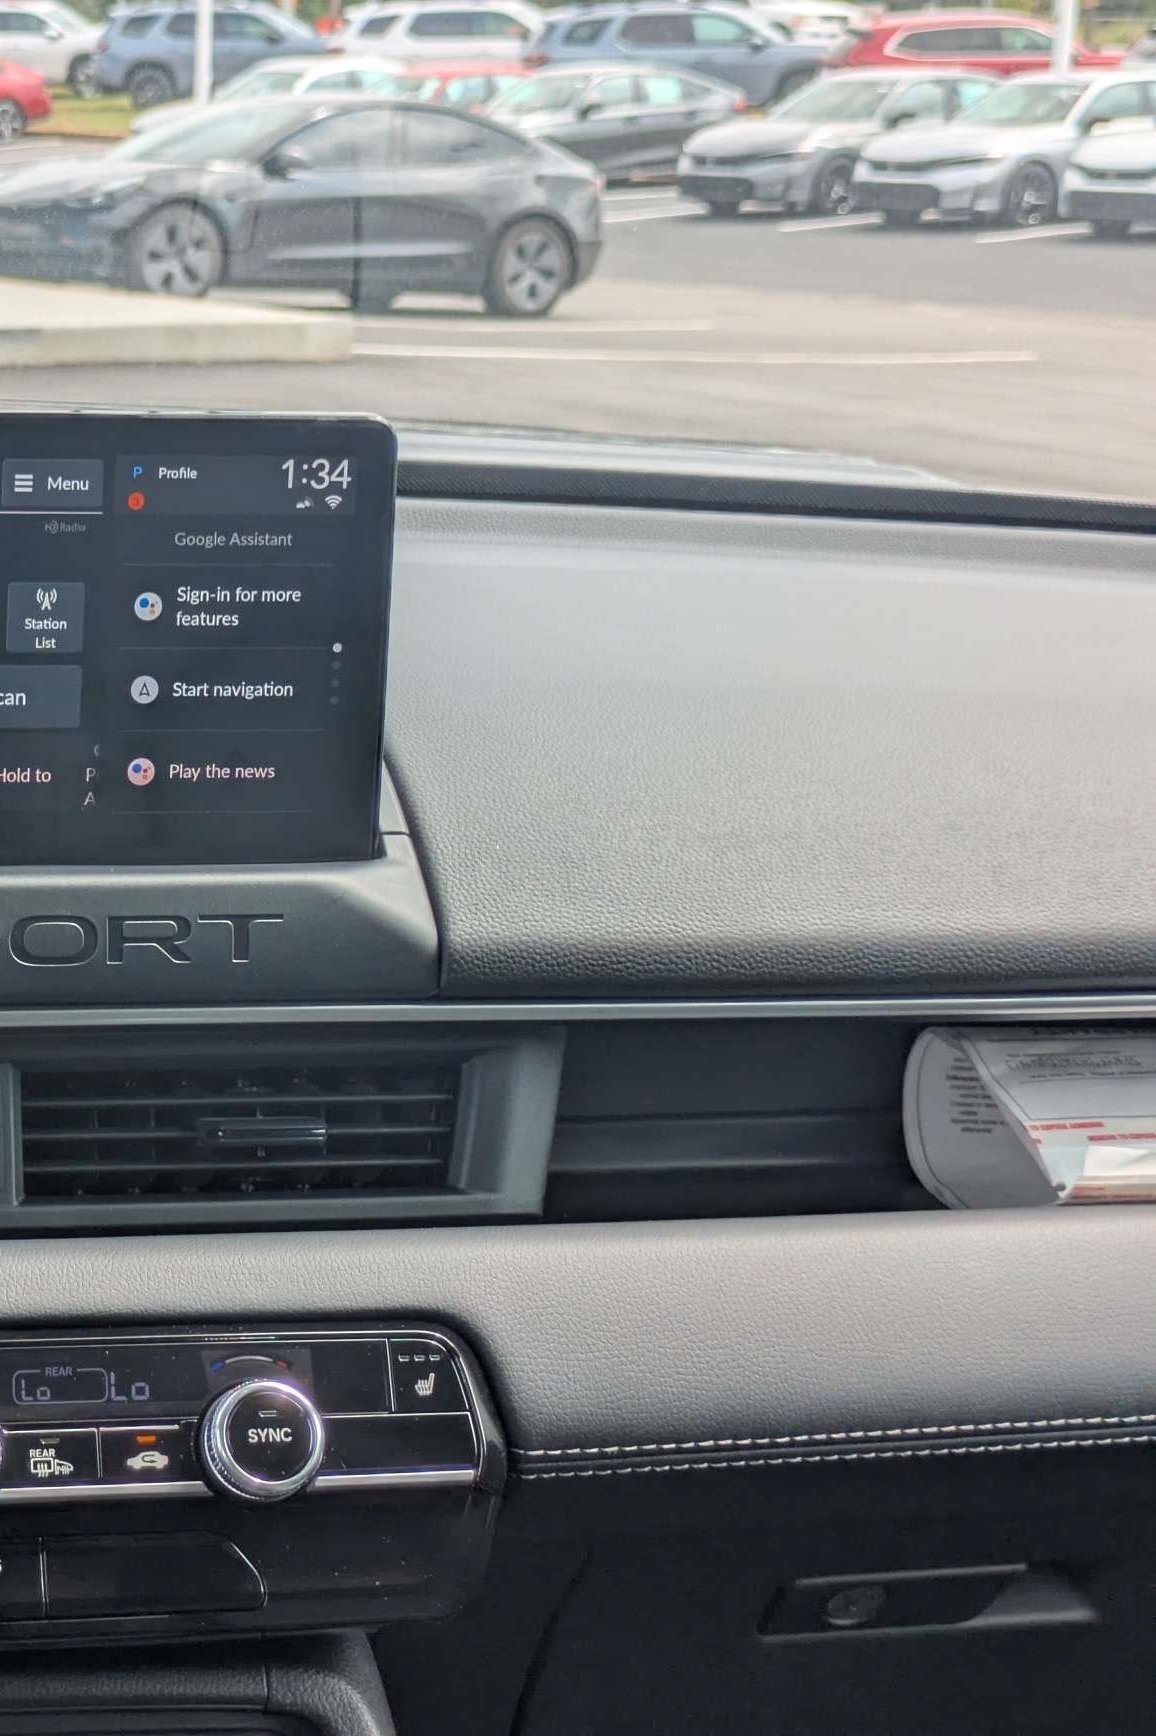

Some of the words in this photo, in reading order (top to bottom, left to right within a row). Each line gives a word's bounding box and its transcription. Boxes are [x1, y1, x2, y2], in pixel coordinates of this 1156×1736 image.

[158, 466, 198, 480] Profile
[281, 458, 352, 490] 1:34
[47, 476, 89, 491] Menu
[174, 531, 226, 549] Google
[229, 532, 293, 547] Assistant
[177, 586, 231, 605] Sign-in
[235, 586, 258, 602] for
[261, 590, 302, 602] more
[24, 617, 67, 630] Station
[176, 610, 239, 627] features
[35, 636, 57, 649] List
[172, 682, 210, 697] Start
[213, 681, 294, 700] navigation
[35, 768, 52, 783] to
[169, 763, 201, 781] Play
[205, 763, 231, 779] the
[235, 767, 275, 779] news
[44, 1366, 73, 1377] REAR
[247, 1427, 293, 1444] SYNC
[29, 1448, 56, 1459] REAR
